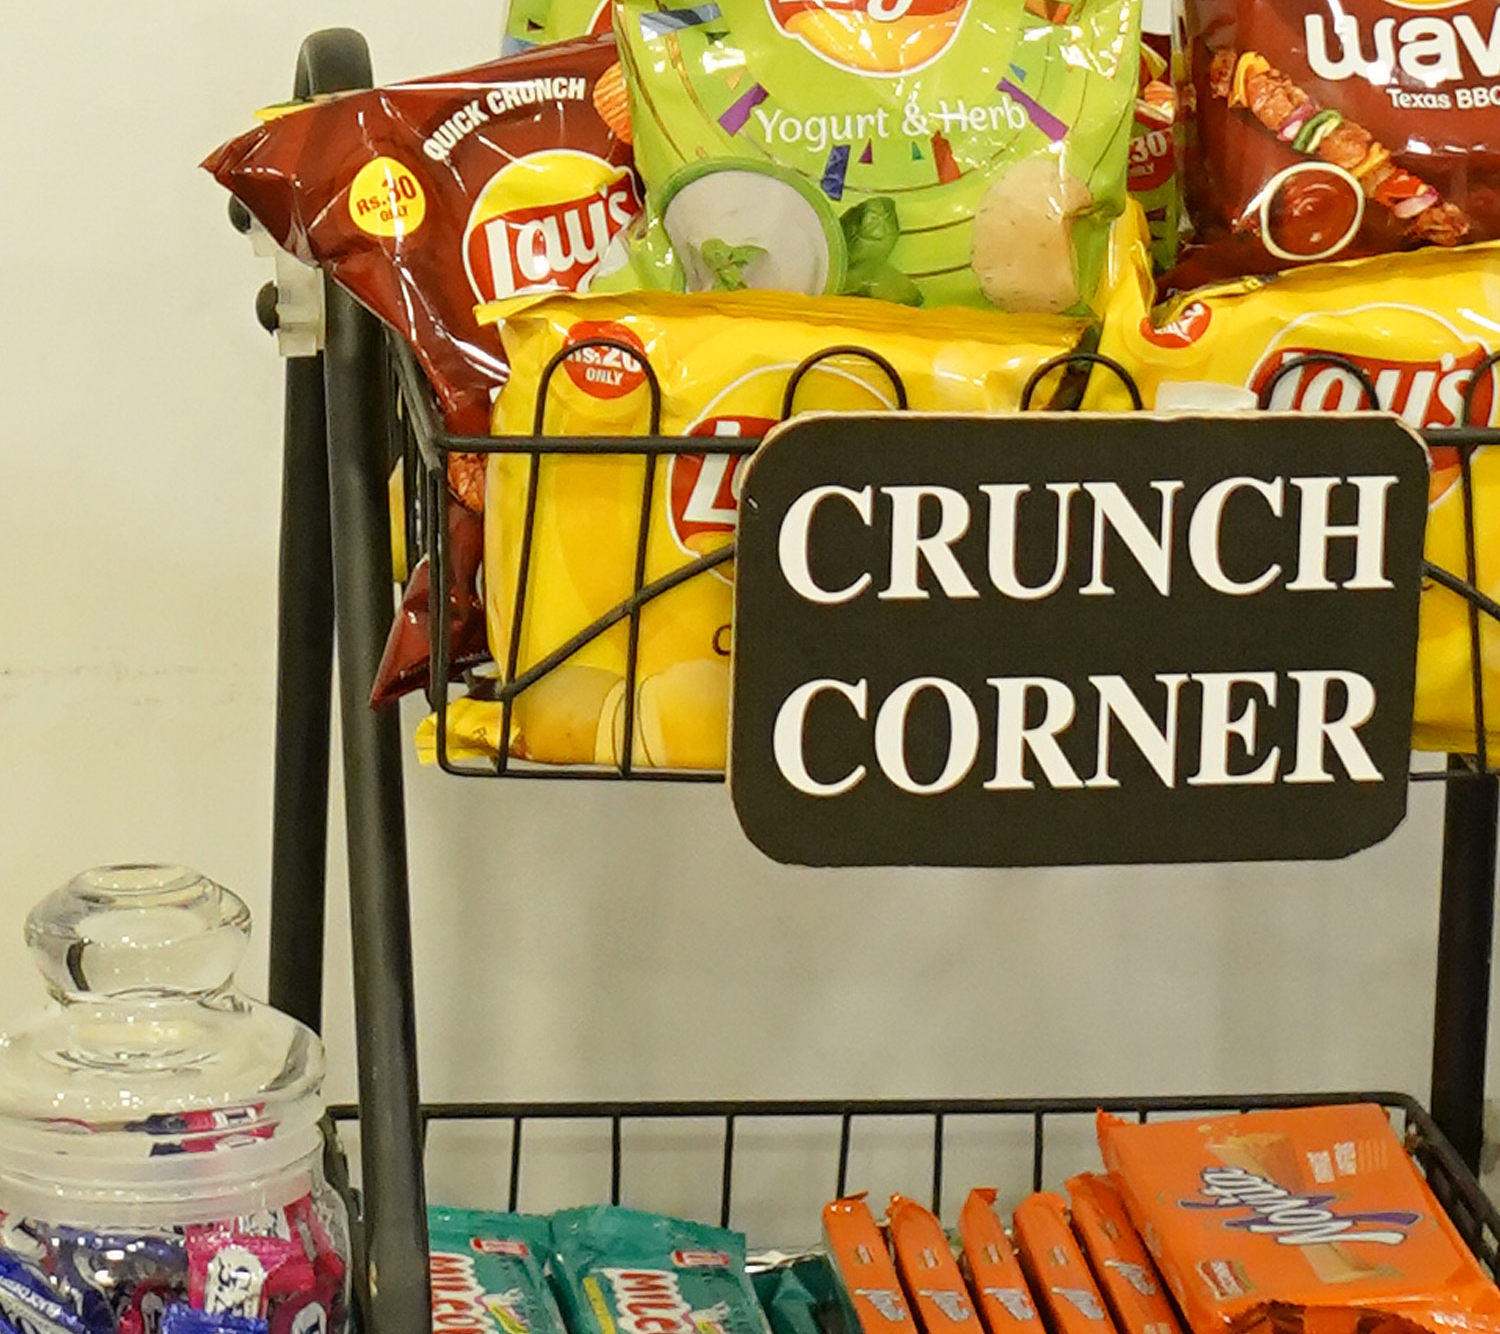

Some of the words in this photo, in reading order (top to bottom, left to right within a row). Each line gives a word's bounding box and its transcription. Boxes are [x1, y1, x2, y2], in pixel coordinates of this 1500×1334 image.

[422, 102, 490, 163] QUICK
[486, 76, 587, 117] CRUNCH
[756, 107, 891, 154] Yogurt
[934, 93, 1030, 137] Herb
[1386, 85, 1451, 110] Texas
[585, 367, 625, 387] ONLY
[778, 475, 1399, 605] CRUNCH
[772, 668, 1385, 796] CORNER
